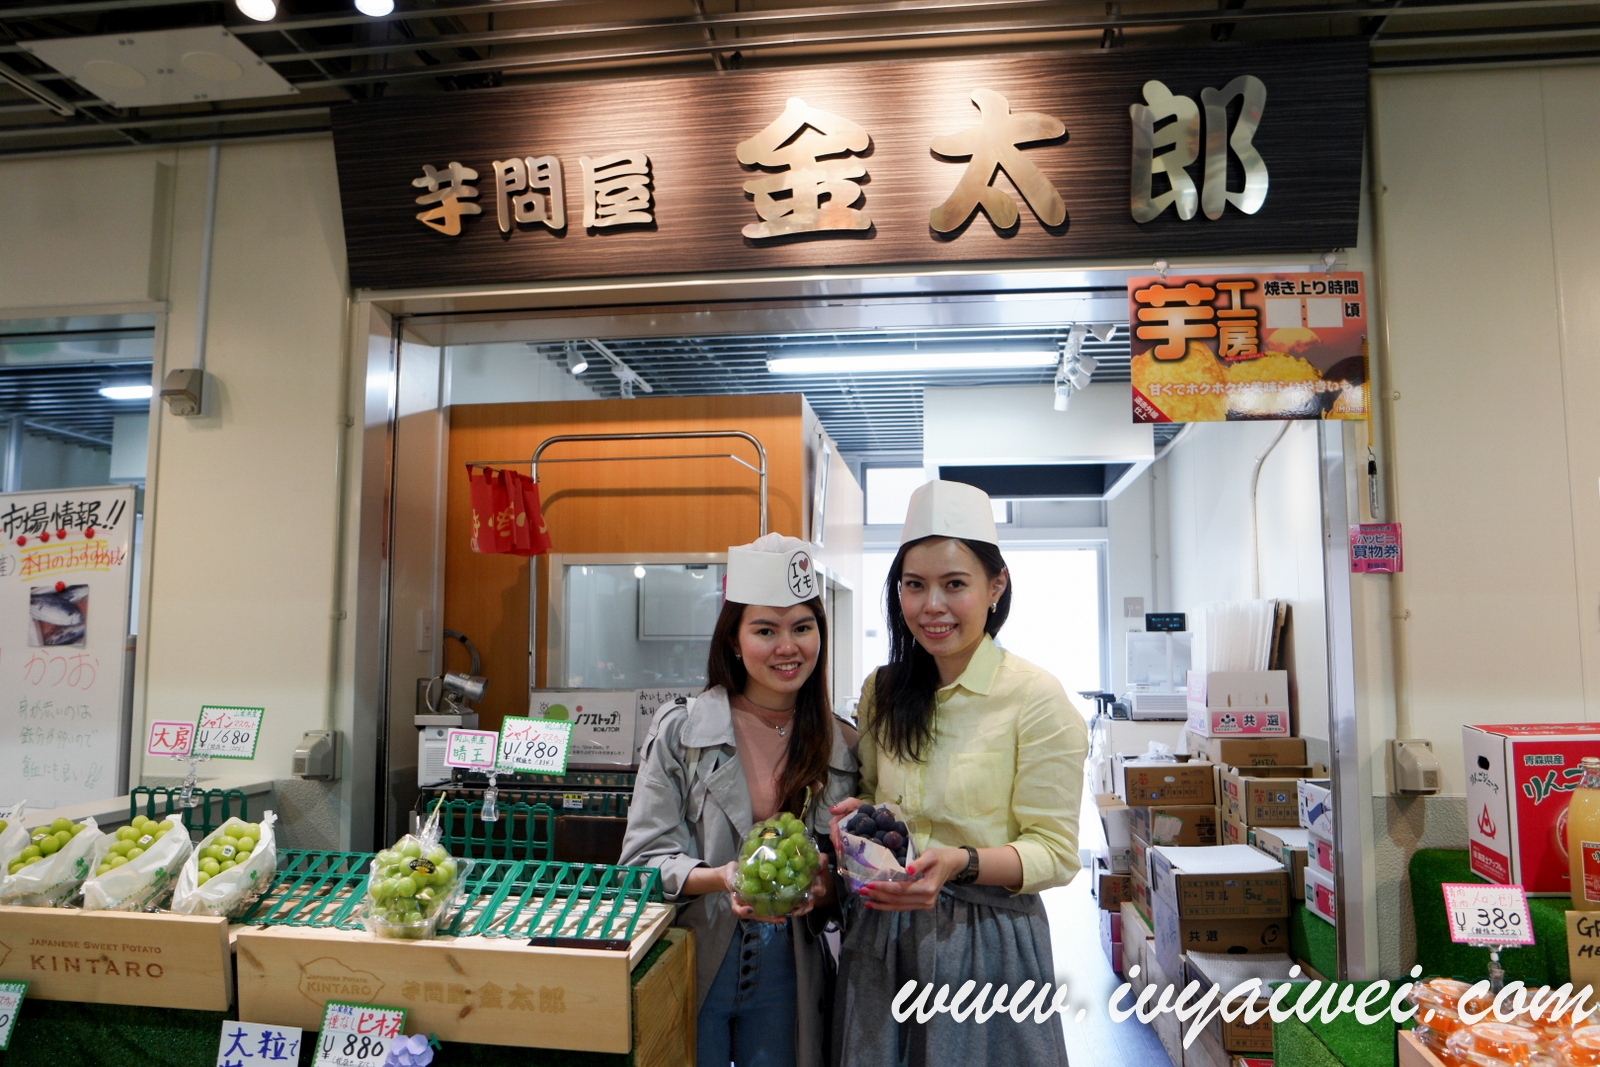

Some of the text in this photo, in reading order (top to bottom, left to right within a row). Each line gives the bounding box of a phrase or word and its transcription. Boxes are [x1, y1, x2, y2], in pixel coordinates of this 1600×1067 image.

[411, 74, 1269, 241] 芋問屋 金太郎
[1263, 279, 1359, 296] 焼き上り時間
[1344, 302, 1361, 318] 頃
[1134, 282, 1218, 361] 芋
[1357, 534, 1396, 544] ハッピー
[1353, 544, 1399, 559] 買物券
[792, 574, 812, 593] イモ
[24, 649, 100, 691] かつお
[18, 697, 93, 720] 身が赤いのは
[200, 712, 257, 729] シャイン マスカット
[152, 726, 191, 751] 大房
[505, 724, 567, 744] シャイン マスカット
[453, 745, 485, 763] 晴王
[1524, 754, 1564, 766] 青森県産
[1467, 891, 1521, 907] メロンゼリー
[1188, 930, 1218, 942] 共選
[30, 954, 164, 979] KINTARO
[307, 981, 372, 996] KINTARO
[478, 980, 566, 1014] 金太郎
[326, 1012, 402, 1039] 種なし ピオーネ
[223, 1027, 299, 1060] 大粒で
